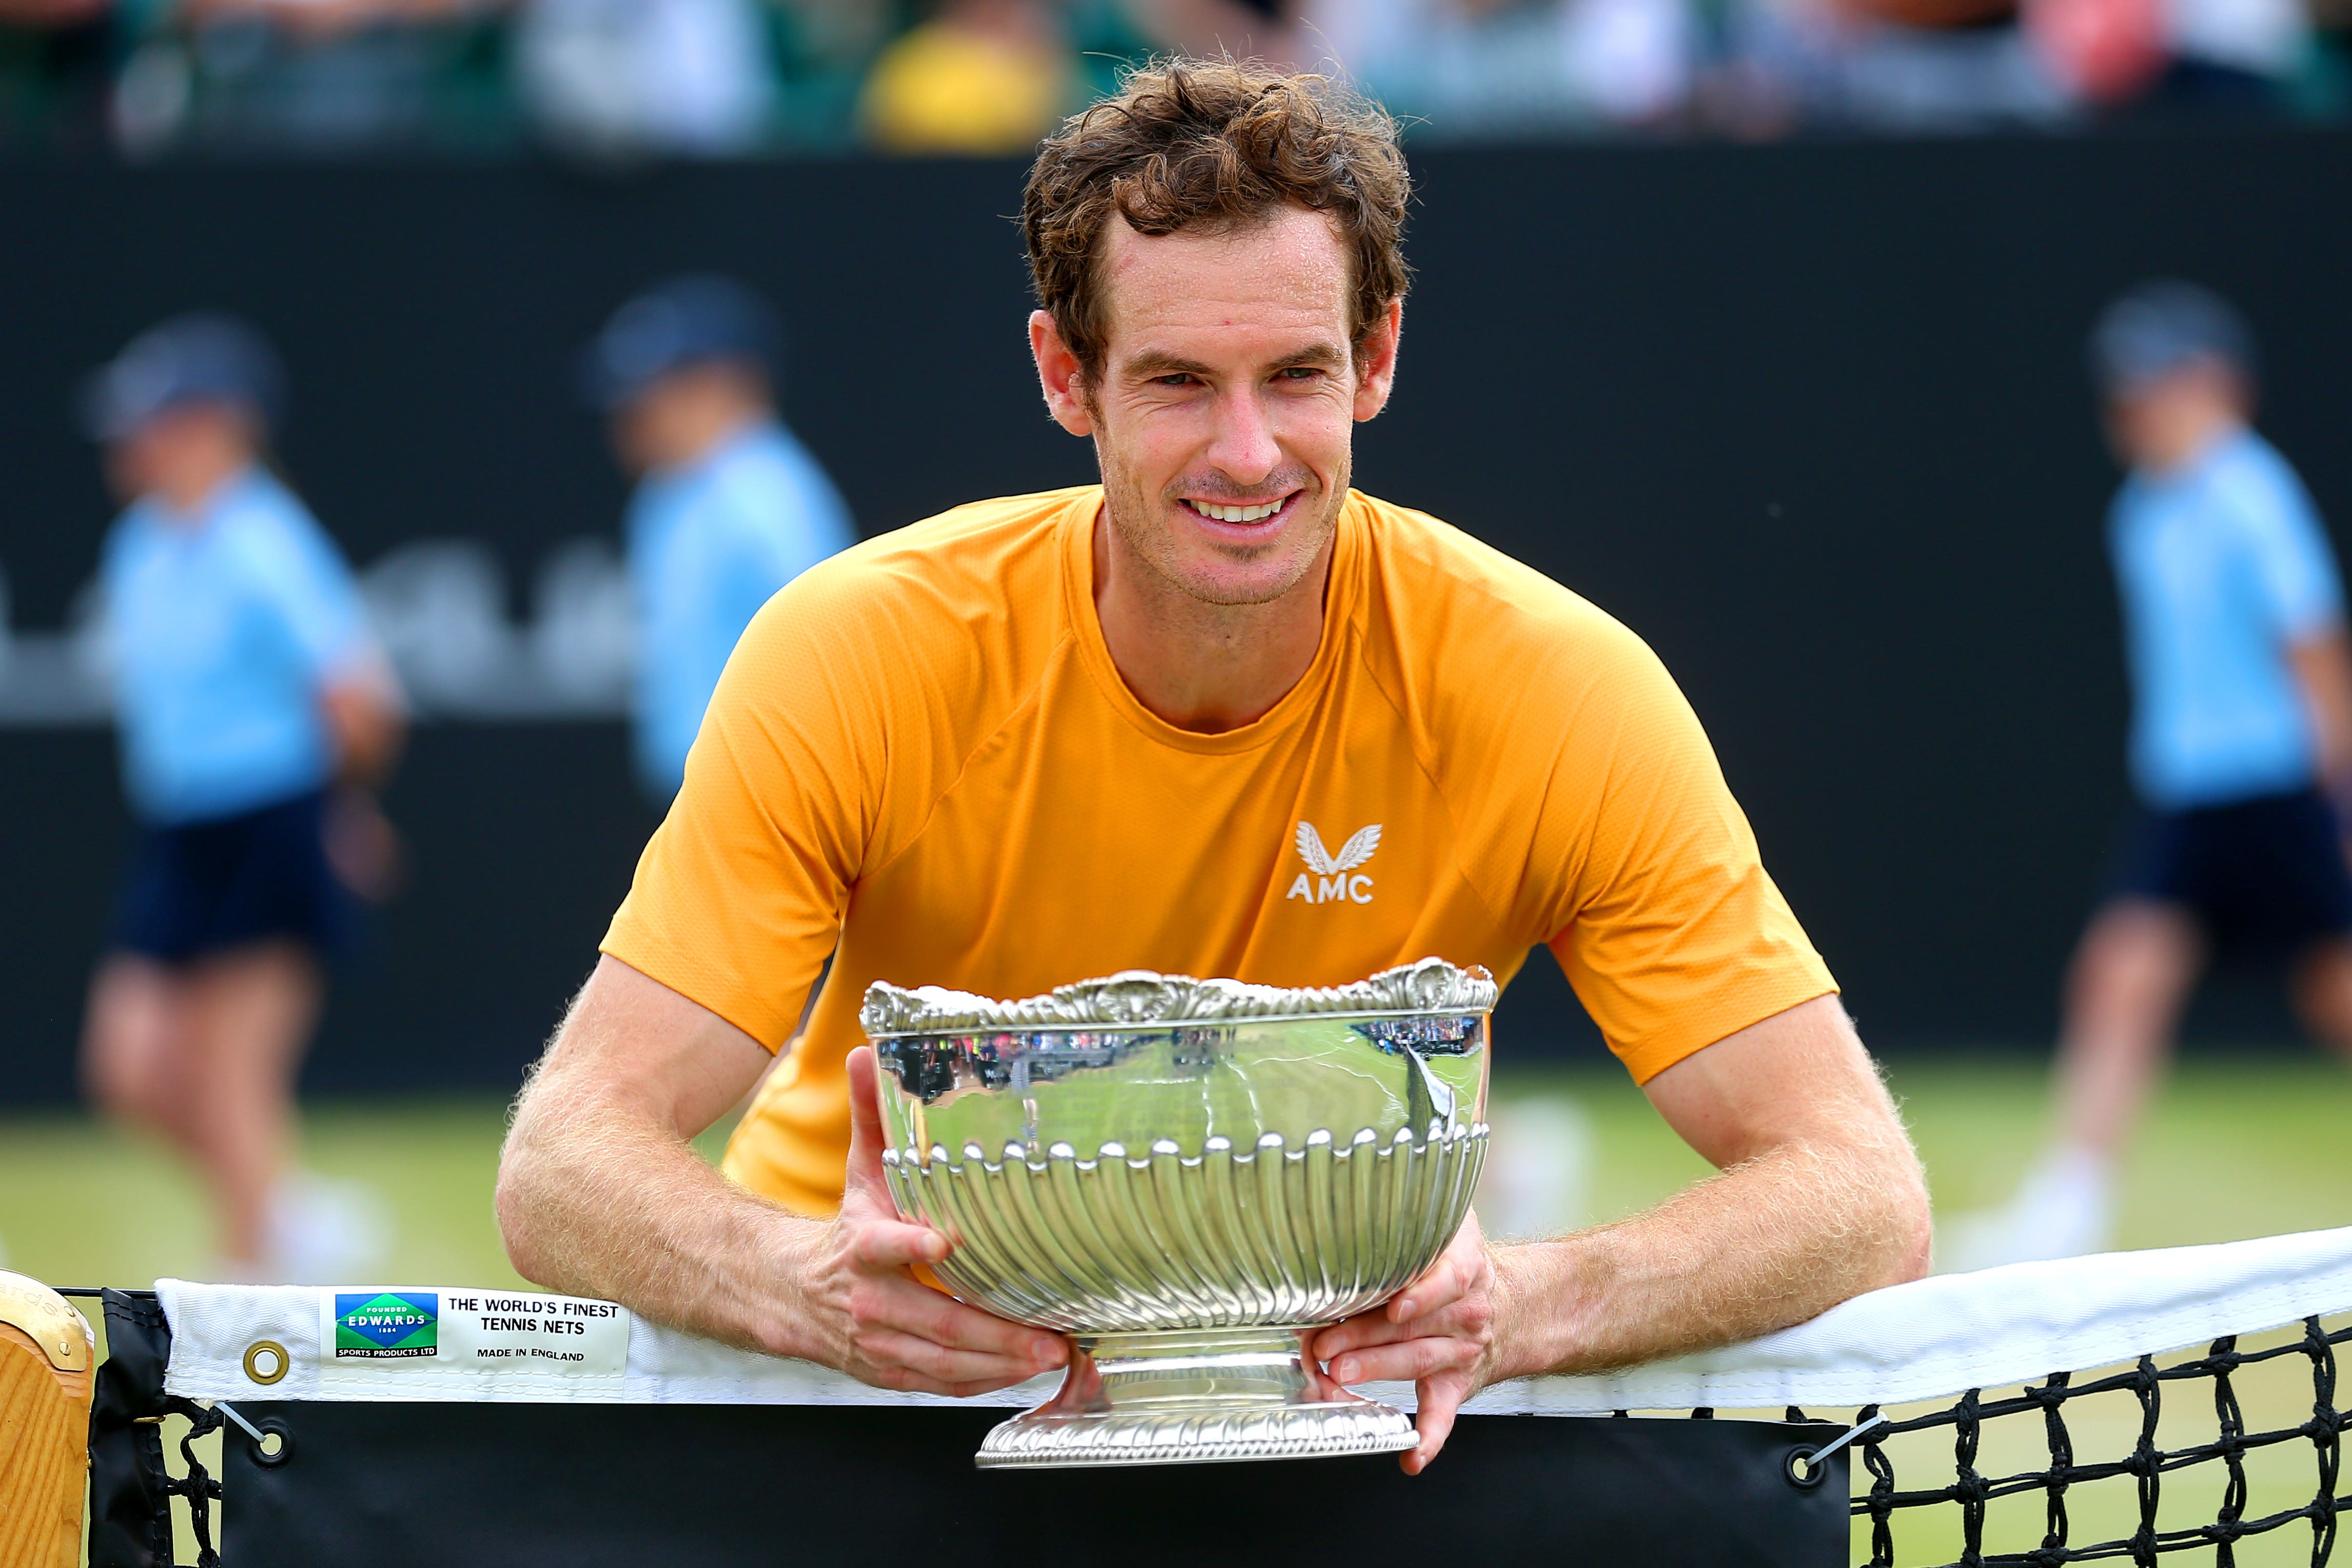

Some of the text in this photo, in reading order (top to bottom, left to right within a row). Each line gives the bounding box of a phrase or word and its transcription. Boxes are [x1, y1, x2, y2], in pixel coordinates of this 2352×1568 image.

[1286, 872, 1375, 905] AMC
[448, 1298, 619, 1318] THE WORLD'S FINEST
[348, 1315, 425, 1326] EDWARDS
[481, 1317, 584, 1335] TENNIS NETS
[477, 1348, 584, 1361] MADE IN ENGLAND
